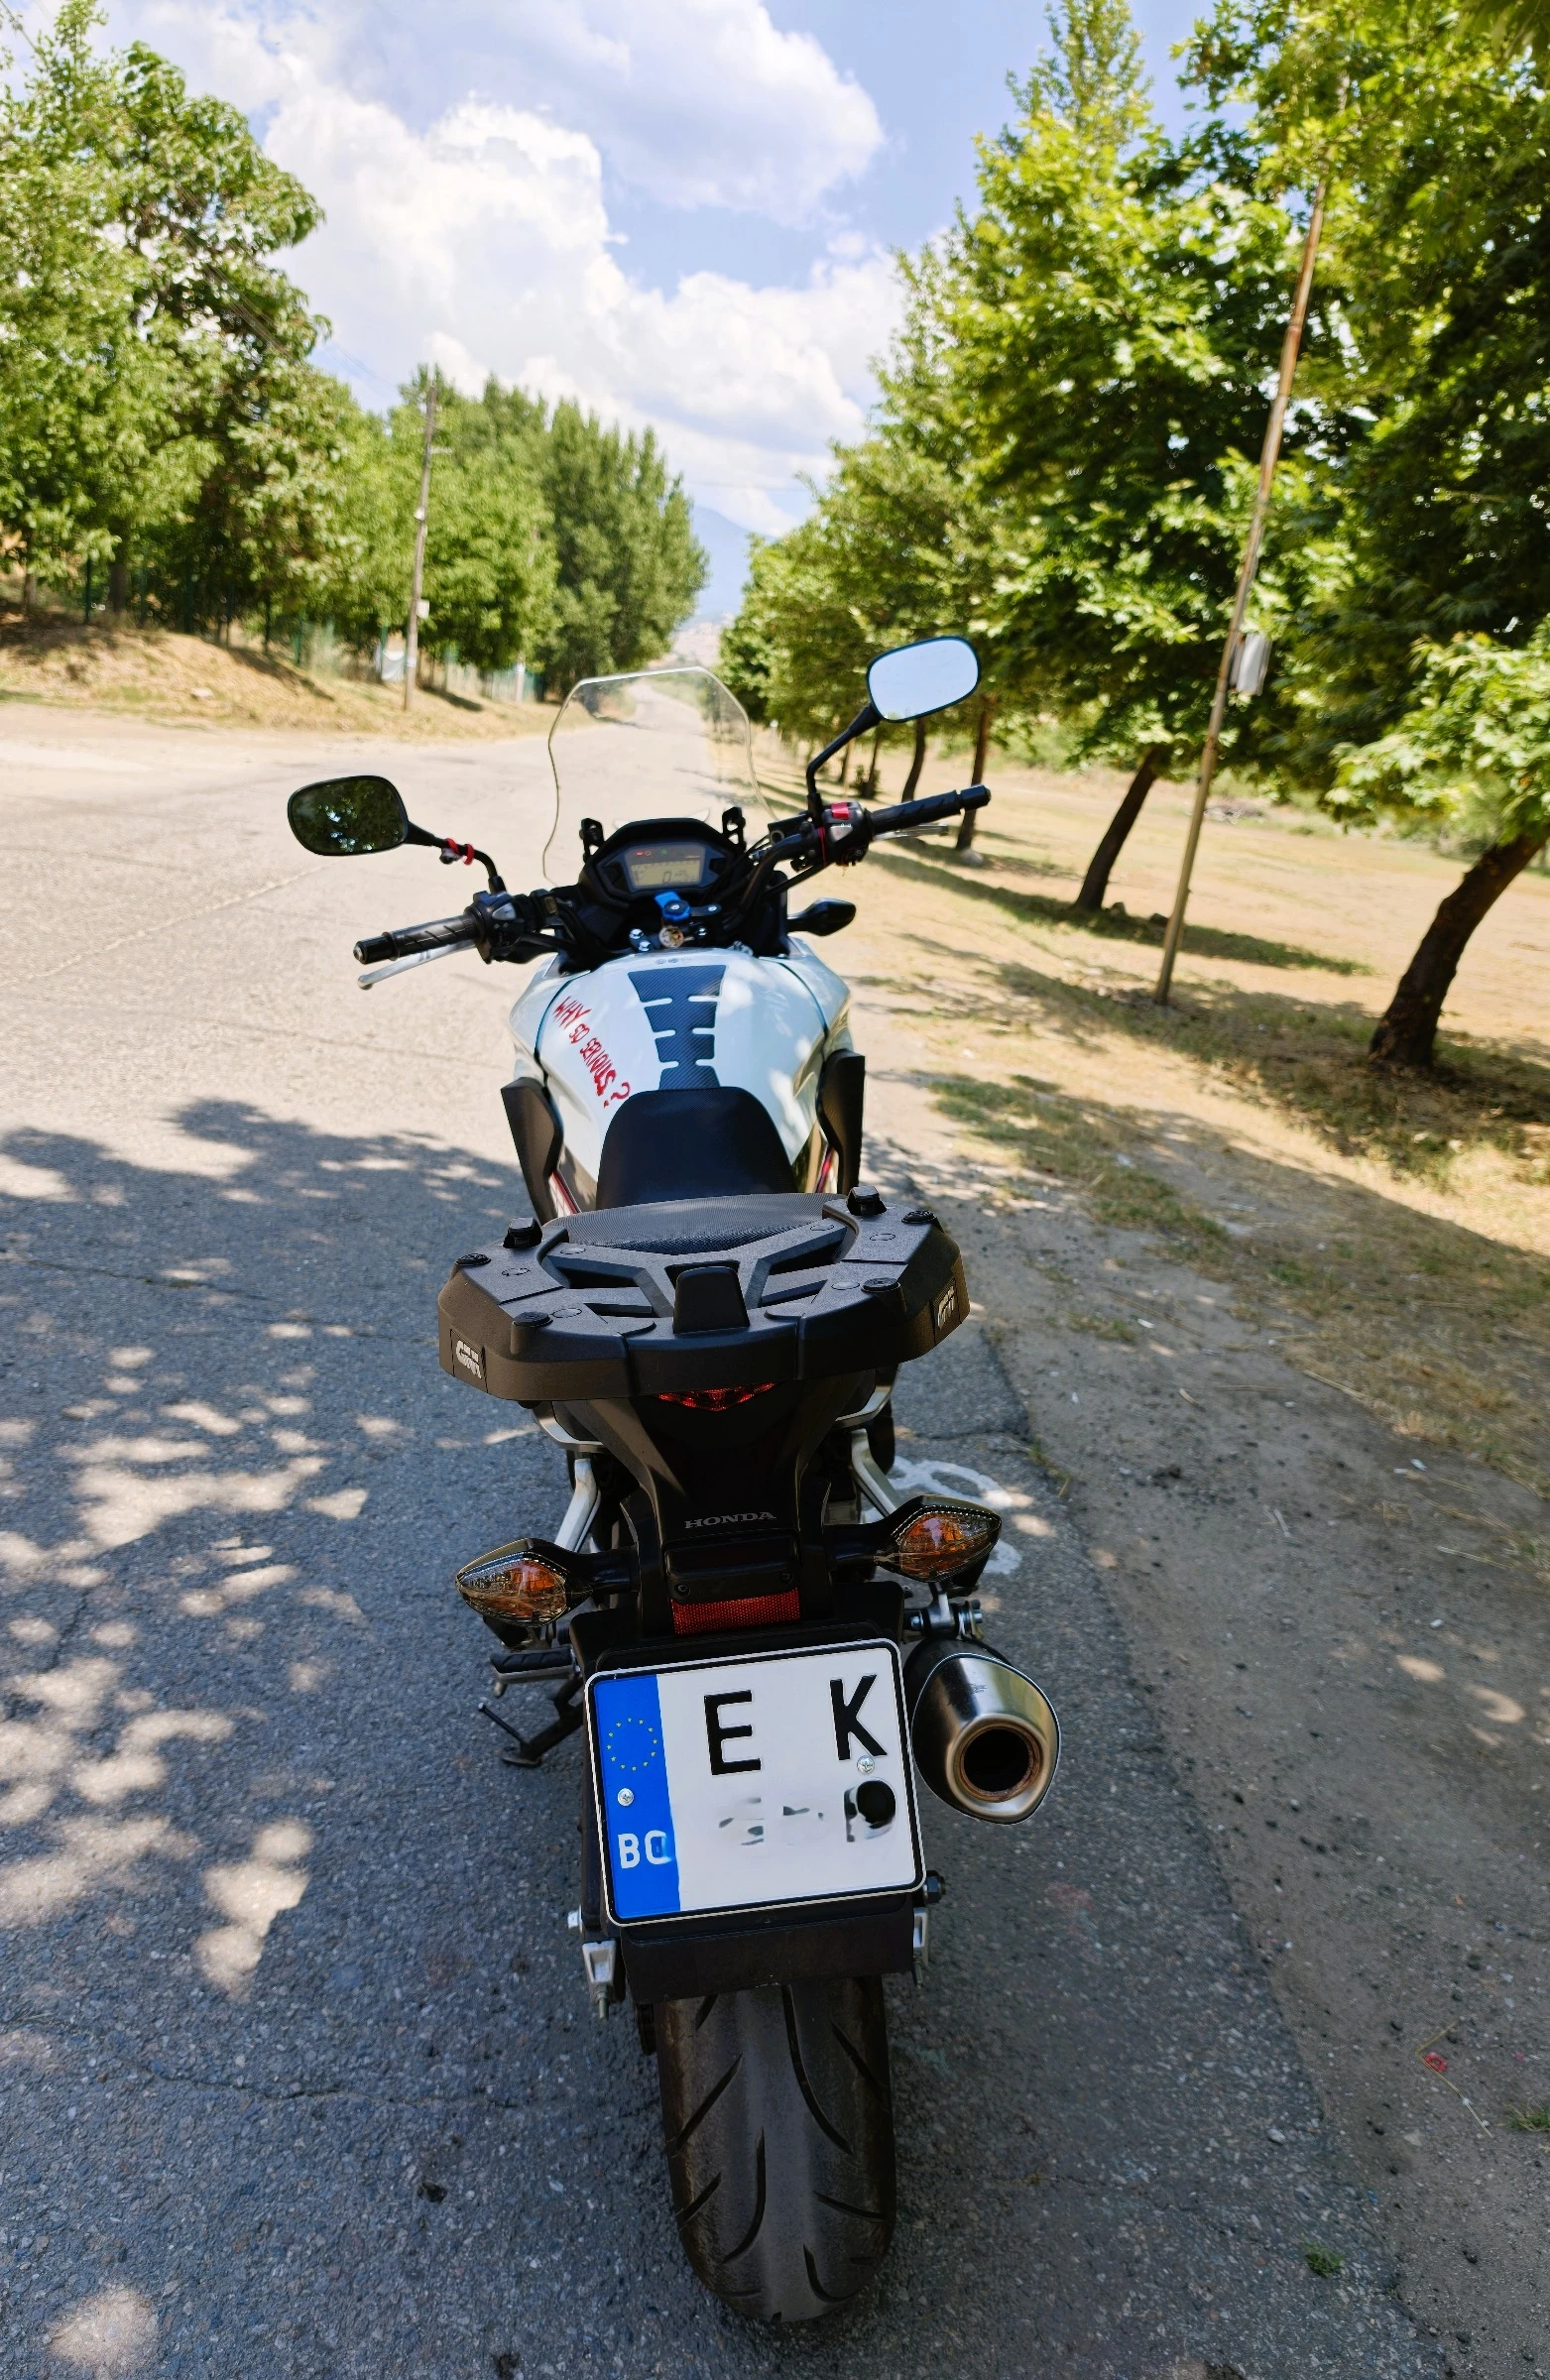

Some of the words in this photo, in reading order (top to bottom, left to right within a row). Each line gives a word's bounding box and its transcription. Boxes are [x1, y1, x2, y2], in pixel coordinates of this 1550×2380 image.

[552, 996, 593, 1030] WHY
[569, 1023, 590, 1044] SO
[684, 1511, 777, 1529] HONDA
[703, 1689, 762, 1776] E
[829, 1674, 889, 1761] K
